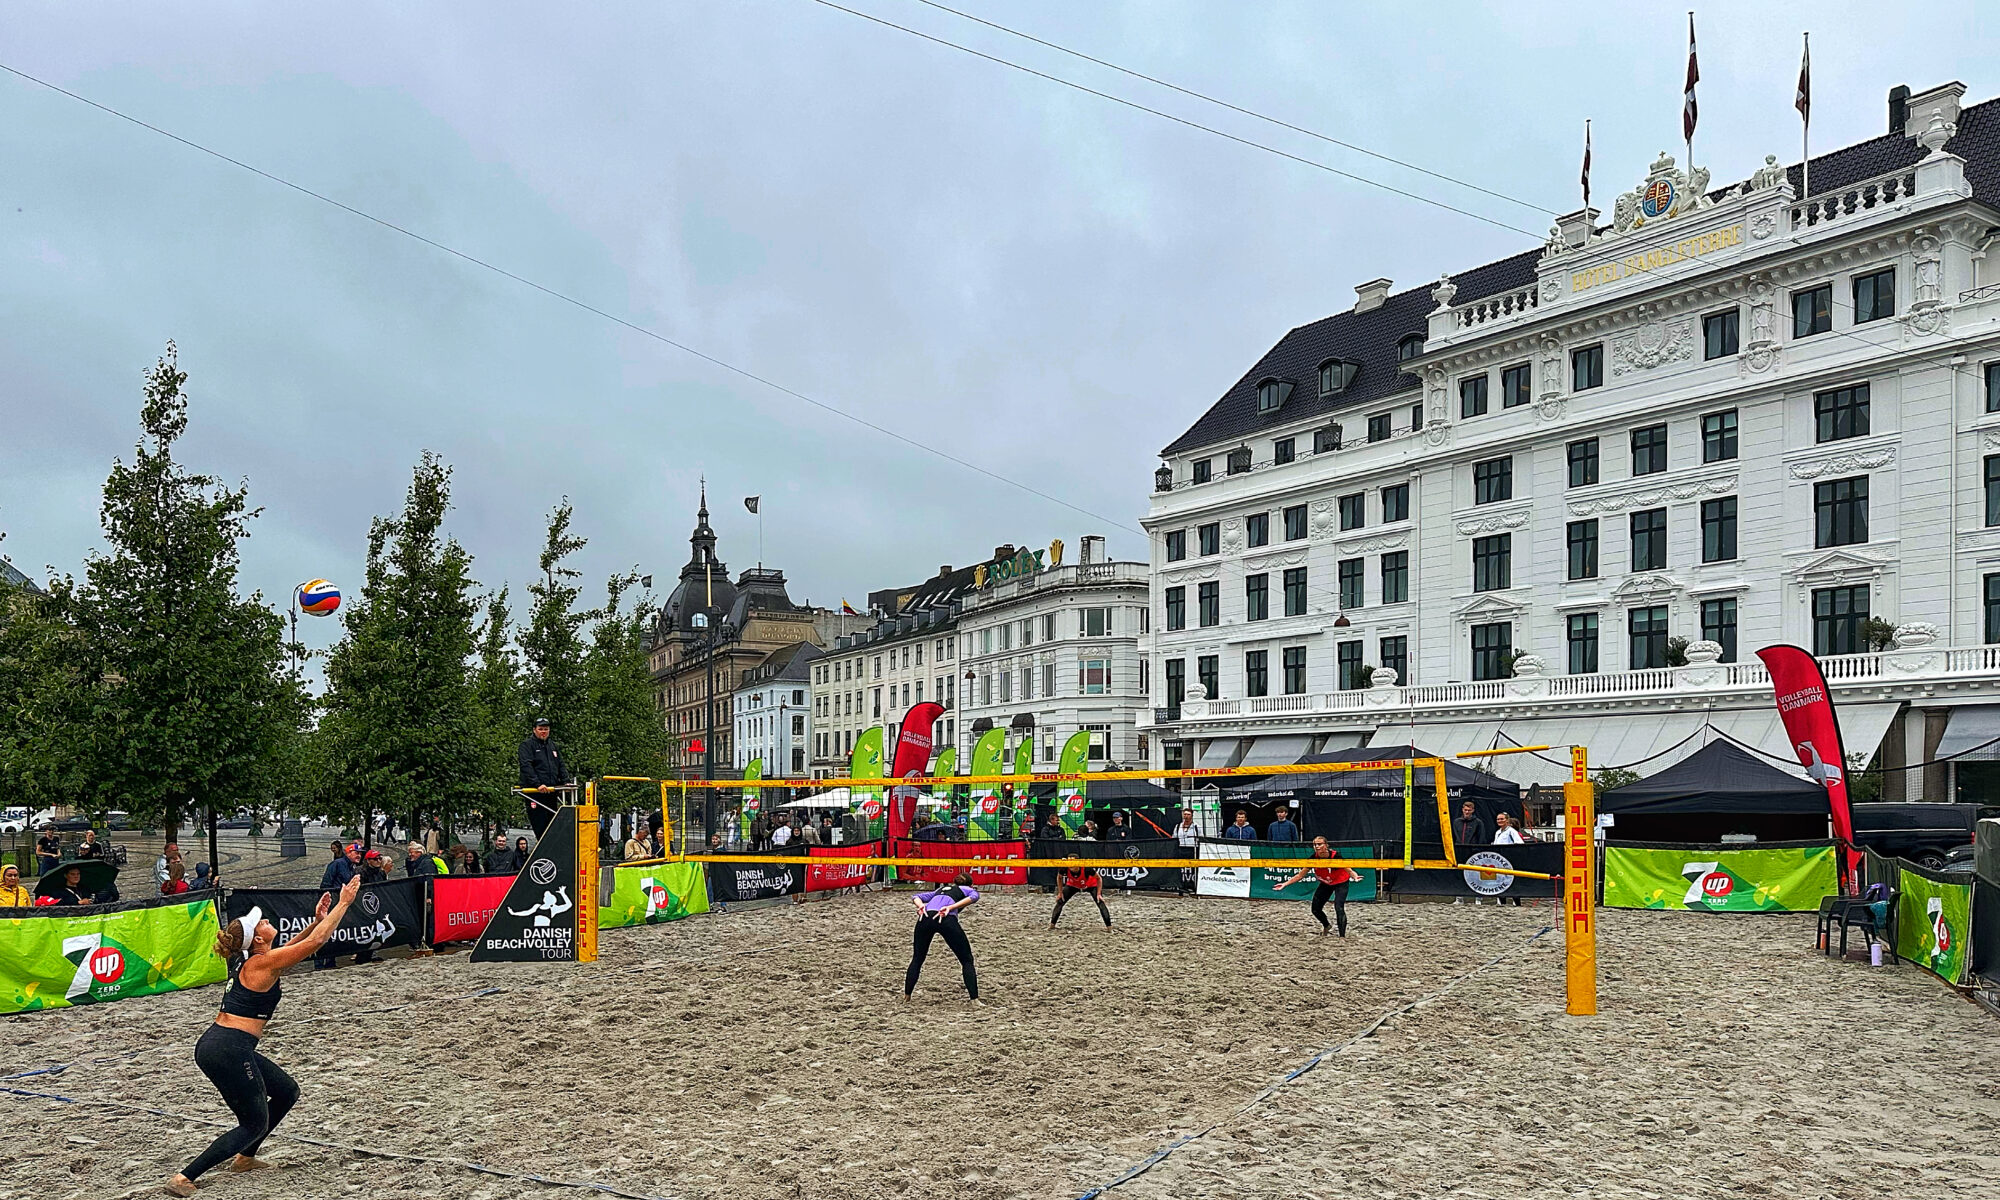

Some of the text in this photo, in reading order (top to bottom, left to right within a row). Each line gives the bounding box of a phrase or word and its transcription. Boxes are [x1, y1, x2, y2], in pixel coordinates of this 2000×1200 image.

[1624, 224, 1744, 278] D'ANGLETERRE
[989, 548, 1045, 585] ROLEX
[1779, 685, 1823, 704] VOLLEYBALL
[1781, 693, 1824, 712] DANMARK
[1033, 773, 1083, 781] FUNTEC
[1181, 767, 1237, 776] FUNTEC
[969, 854, 1018, 875] ALLE
[1570, 805, 1589, 934] FUNTEC
[736, 868, 765, 881] DANISH
[1201, 874, 1248, 885] Andelskassen
[1264, 874, 1282, 882] brug
[737, 876, 784, 890] BEACHVOLLEY
[737, 889, 758, 900] TOUR
[578, 861, 587, 949] FUNTEC
[448, 908, 496, 926] BRUG FO
[523, 927, 572, 939] DANISH
[486, 938, 572, 950] BEACHVOLLEY
[539, 948, 572, 959] TOUR
[62, 933, 120, 1001] 7up
[96, 984, 121, 994] ZERO
